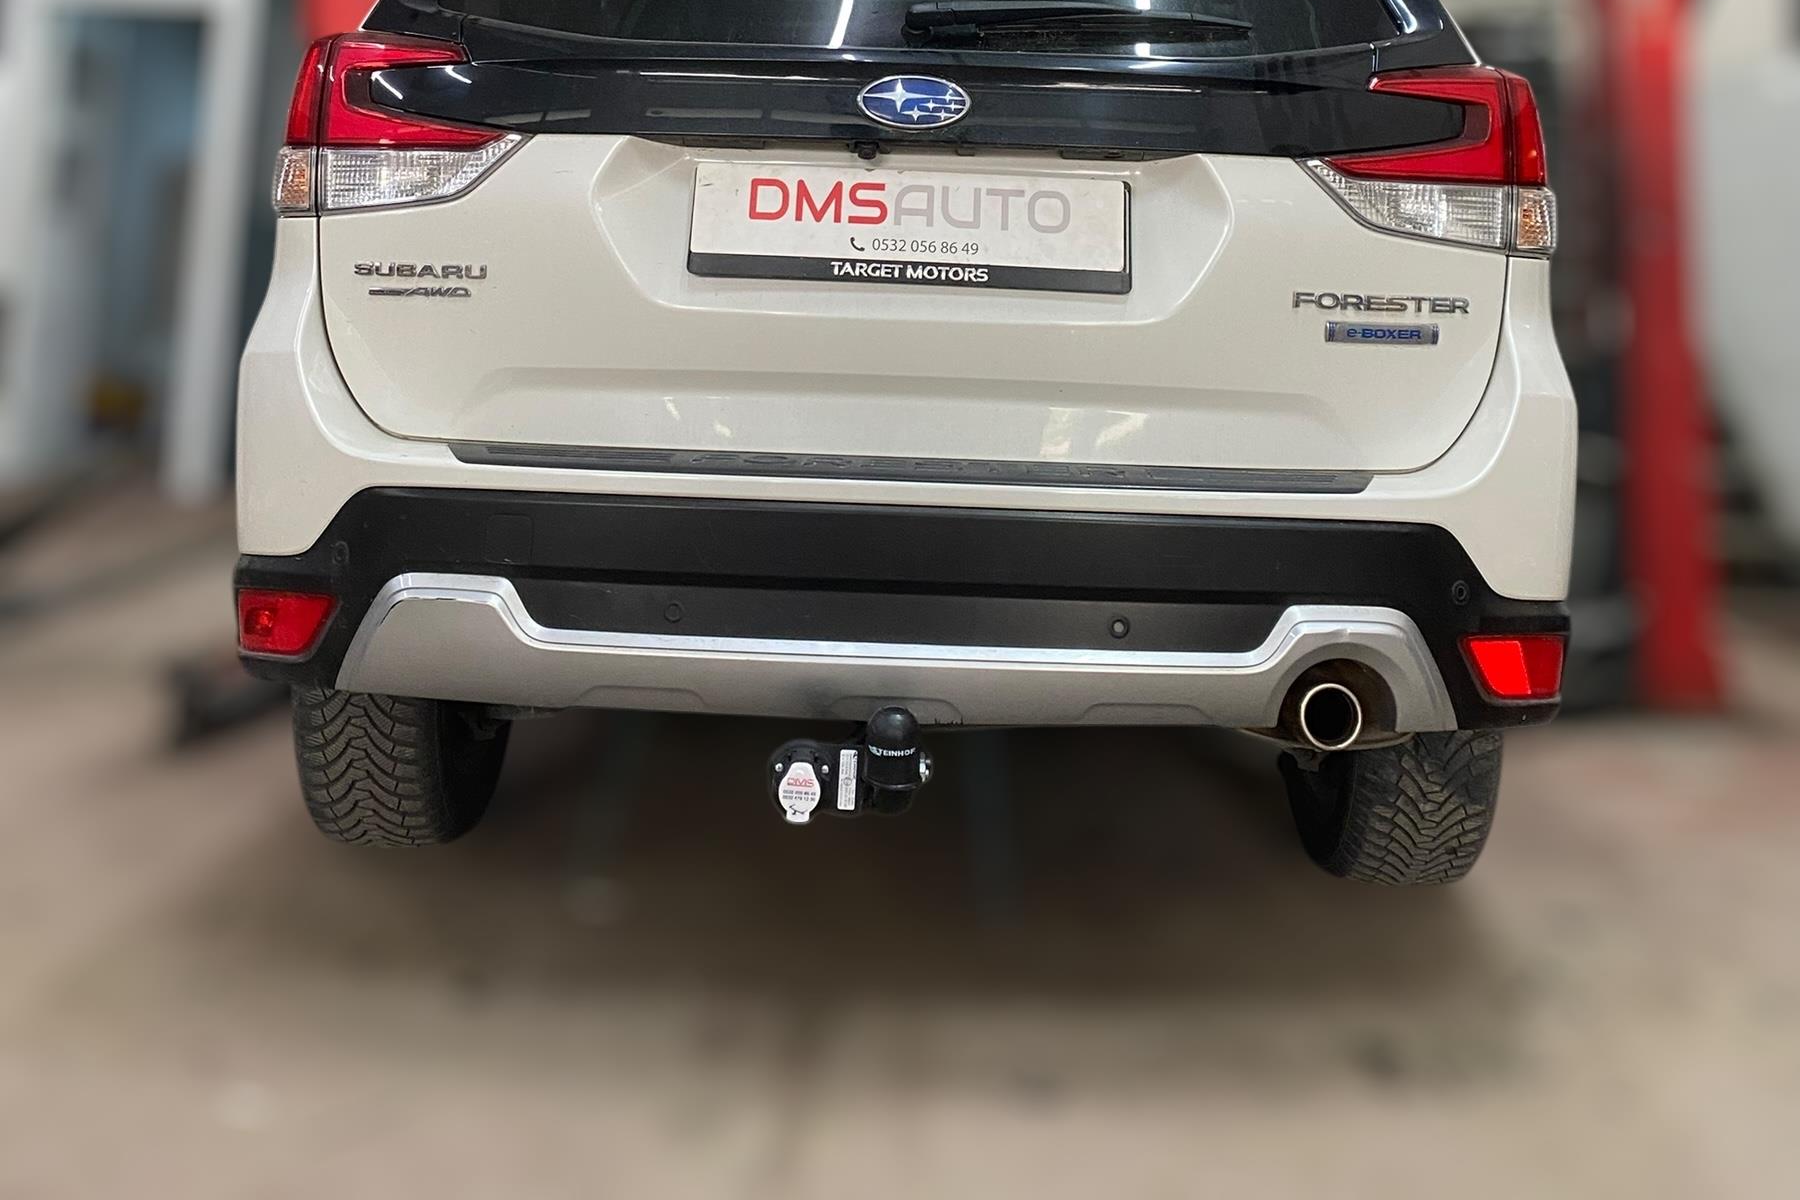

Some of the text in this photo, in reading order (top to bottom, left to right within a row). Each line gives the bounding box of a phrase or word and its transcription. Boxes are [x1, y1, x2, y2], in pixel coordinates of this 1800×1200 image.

[748, 177, 1071, 234] DMSAUTO
[872, 238, 979, 255] 0532 056 86 49
[354, 261, 488, 280] SUBARU
[831, 261, 989, 282] TARGET MOTORS
[404, 286, 472, 298] AWD
[1292, 291, 1470, 315] FORESTER
[1347, 327, 1422, 340] e-BOXER
[690, 453, 1126, 479] FORESTER
